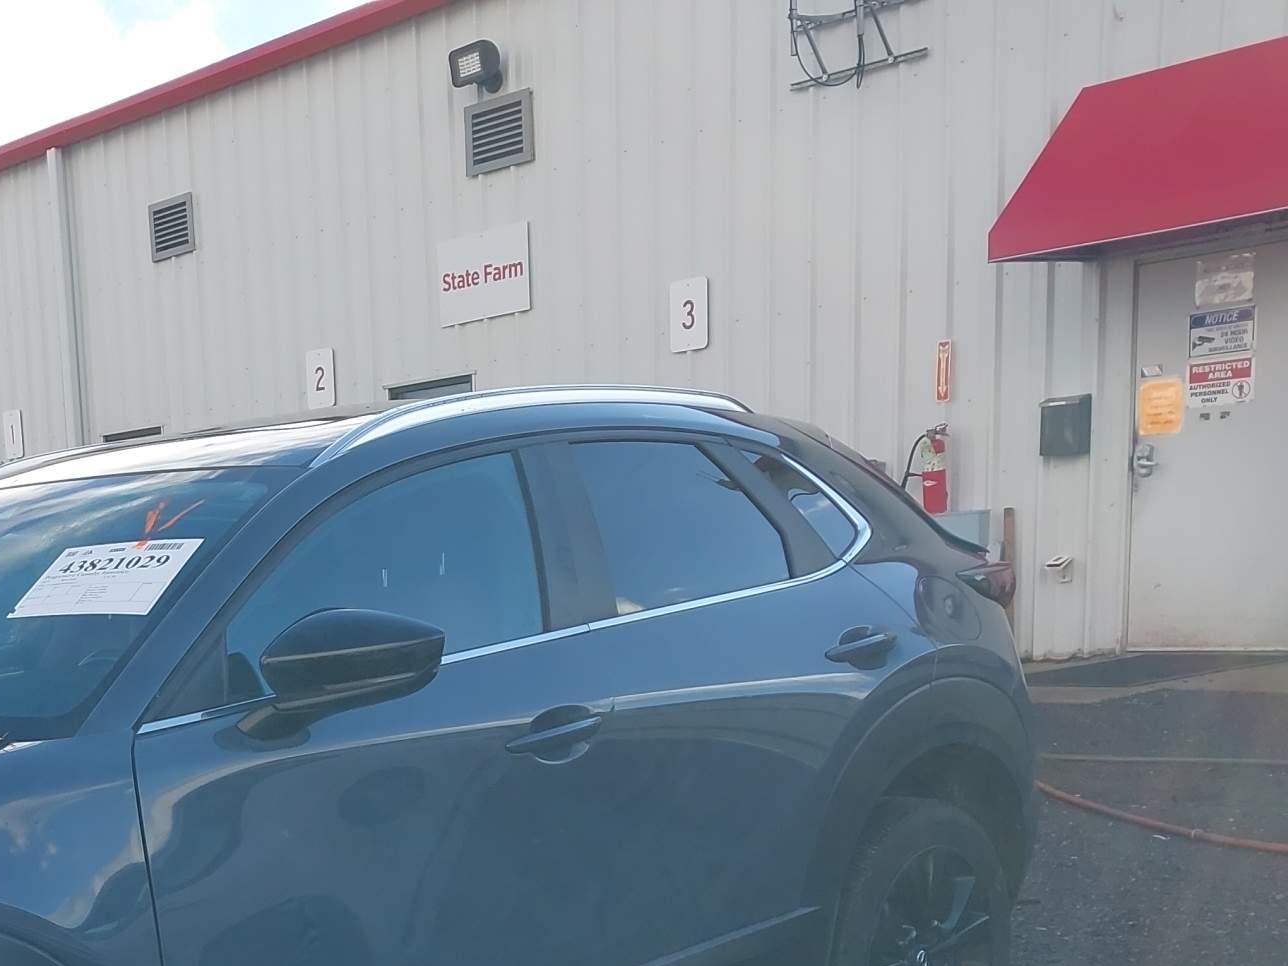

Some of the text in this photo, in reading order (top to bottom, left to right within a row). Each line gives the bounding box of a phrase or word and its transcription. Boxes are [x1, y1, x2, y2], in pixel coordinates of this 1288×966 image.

[442, 261, 524, 292] State Farm
[682, 299, 695, 330] 3
[1205, 310, 1239, 324] NOTICE
[1224, 336, 1244, 345] VIDEO
[1192, 360, 1250, 374] RESTRICTED
[314, 366, 326, 392] 2
[1207, 370, 1233, 380] AREA
[1189, 381, 1231, 391] AUTHORIZED
[1190, 388, 1229, 398] PERSONNEL
[1200, 396, 1218, 404] ONLY
[58, 554, 171, 574] 43821029
